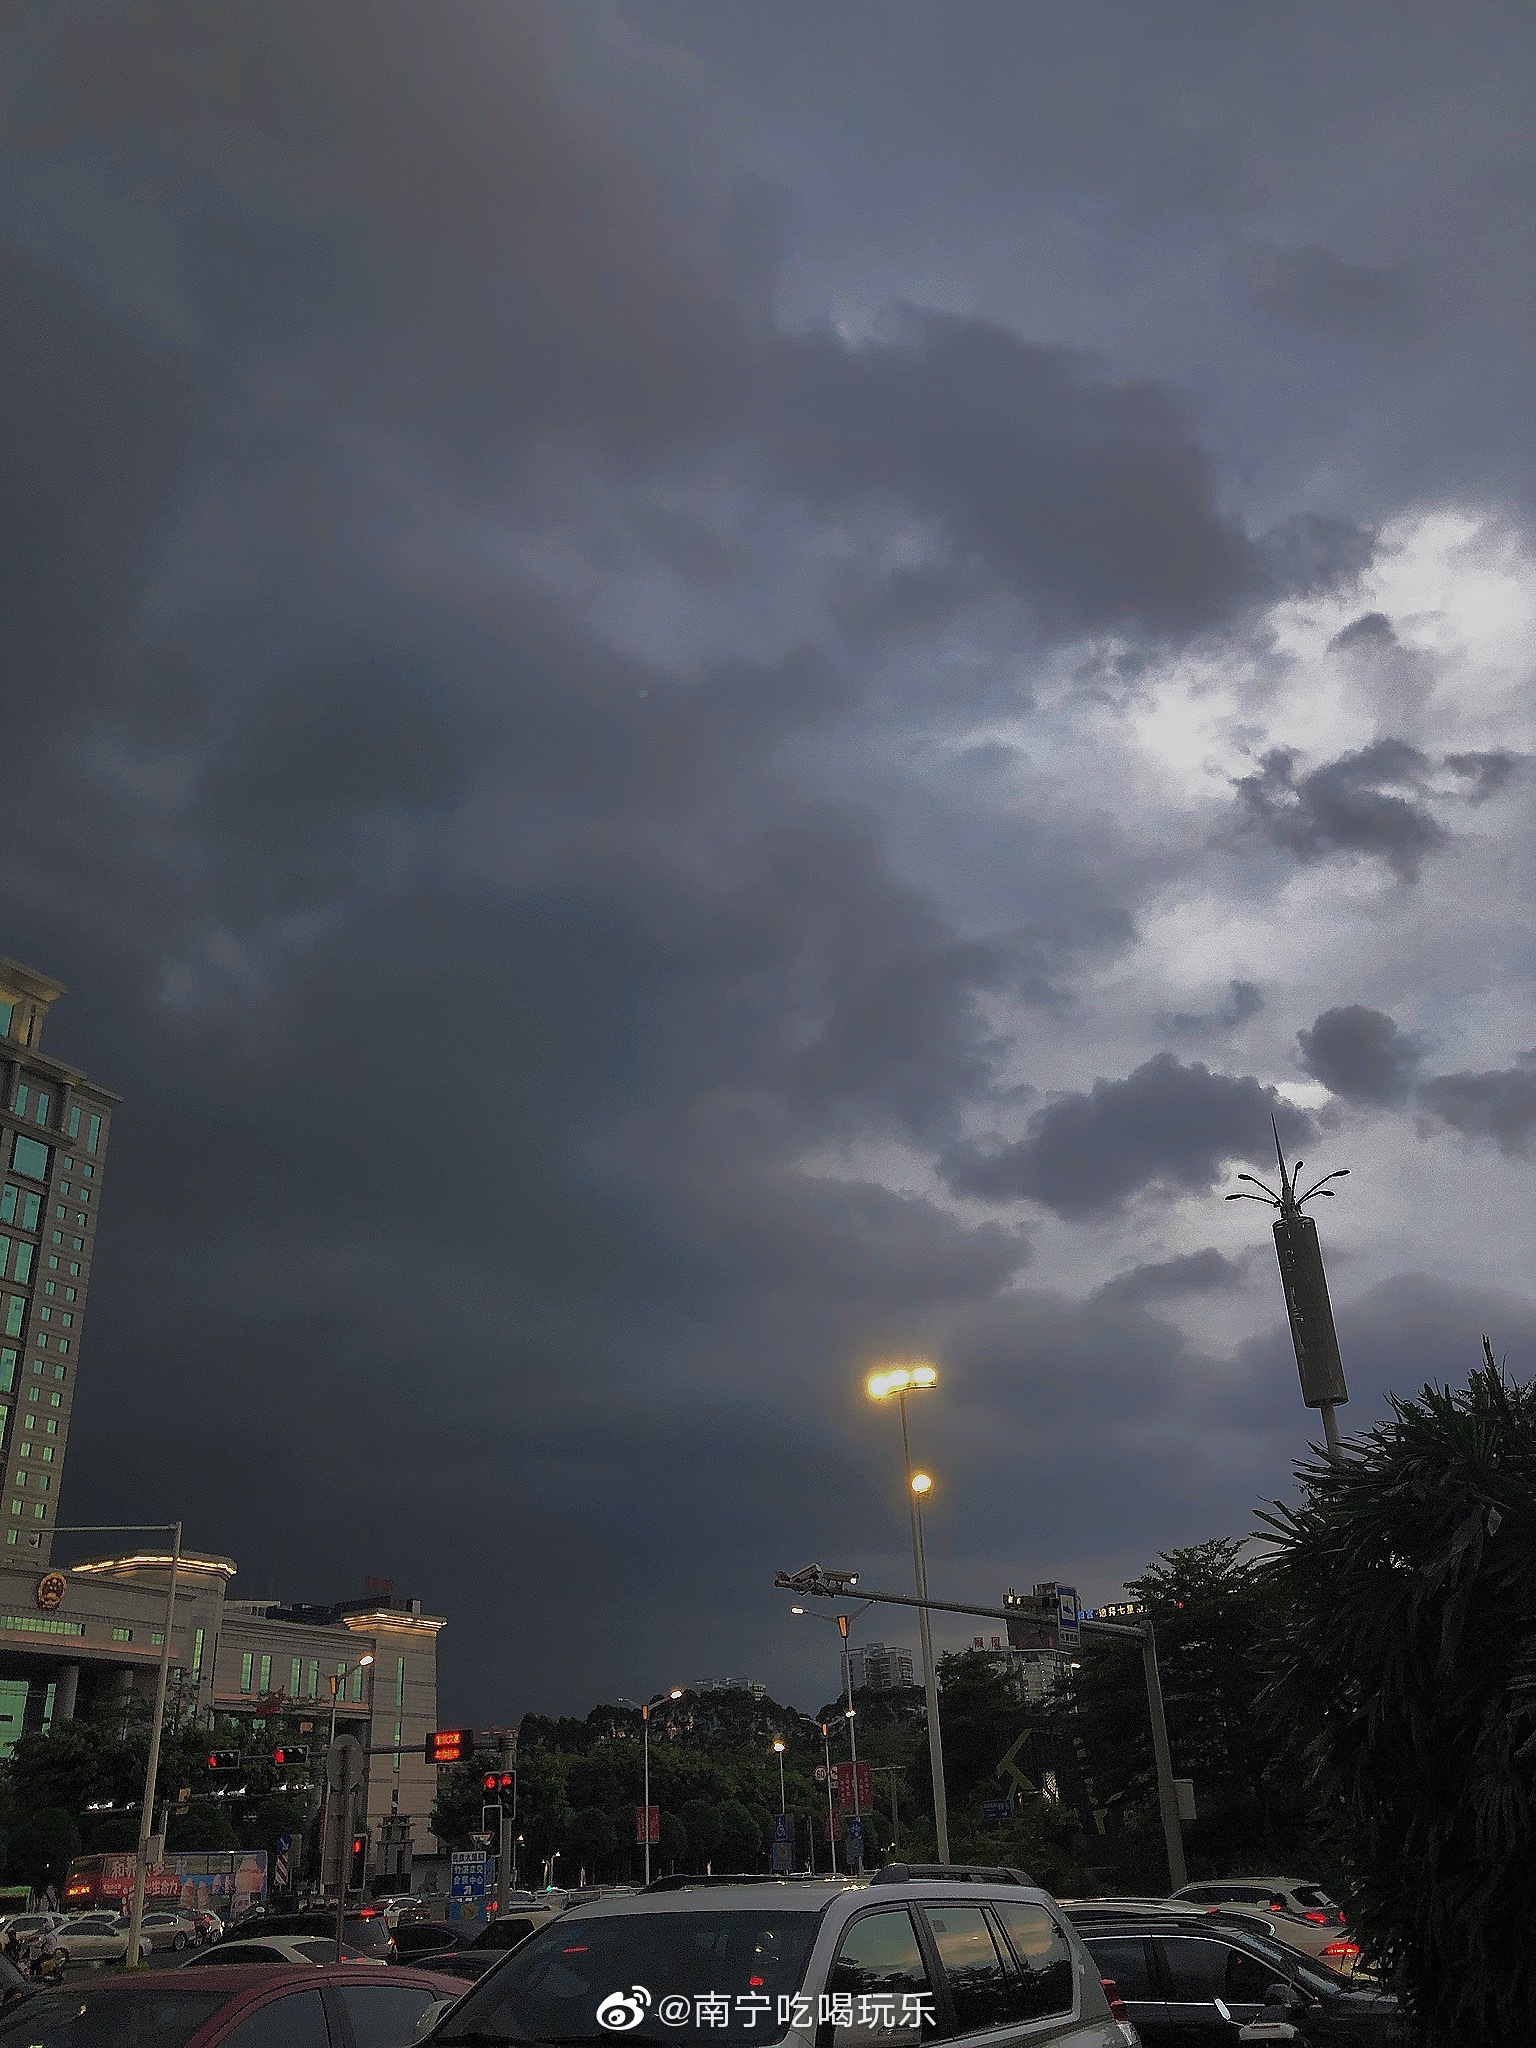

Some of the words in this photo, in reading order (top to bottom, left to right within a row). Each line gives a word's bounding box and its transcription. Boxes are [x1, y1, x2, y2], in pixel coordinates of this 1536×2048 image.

[816, 1769, 825, 1779] 60
[454, 1875, 484, 1886] 会展中心
